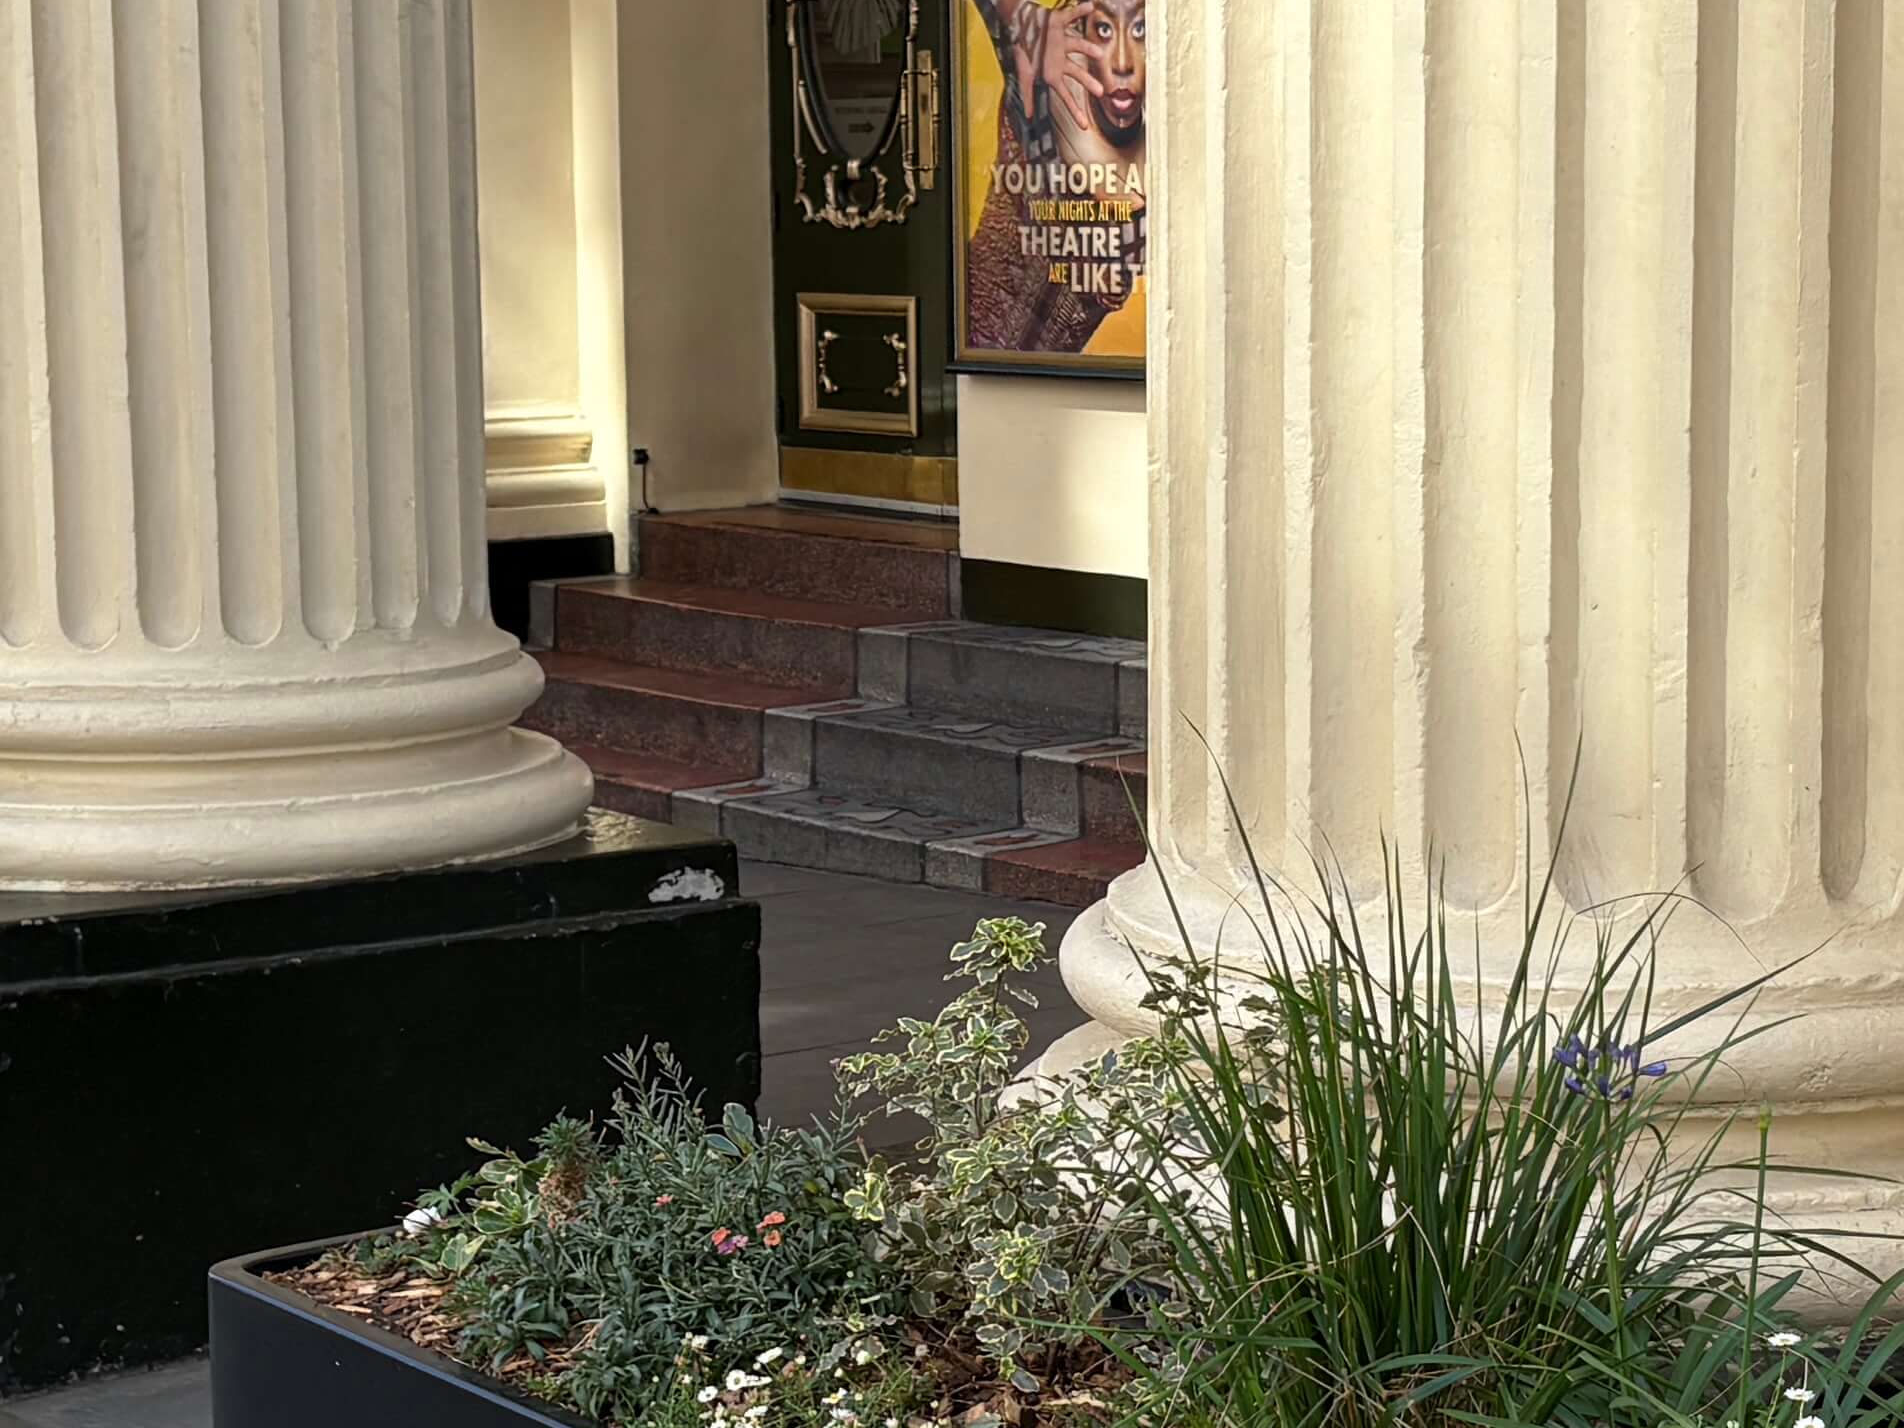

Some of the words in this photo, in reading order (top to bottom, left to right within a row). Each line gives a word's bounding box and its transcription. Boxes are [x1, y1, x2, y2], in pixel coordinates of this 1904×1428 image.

[1049, 163, 1117, 194] HOPE
[1124, 163, 1146, 194] A
[1028, 200, 1056, 221] YOUR
[1058, 200, 1095, 222] NIGHTS
[1098, 200, 1111, 221] AT
[1112, 201, 1132, 221] THE
[1017, 225, 1121, 258] THEATRE
[1048, 262, 1068, 284] ARE
[1070, 262, 1122, 294] LIKE
